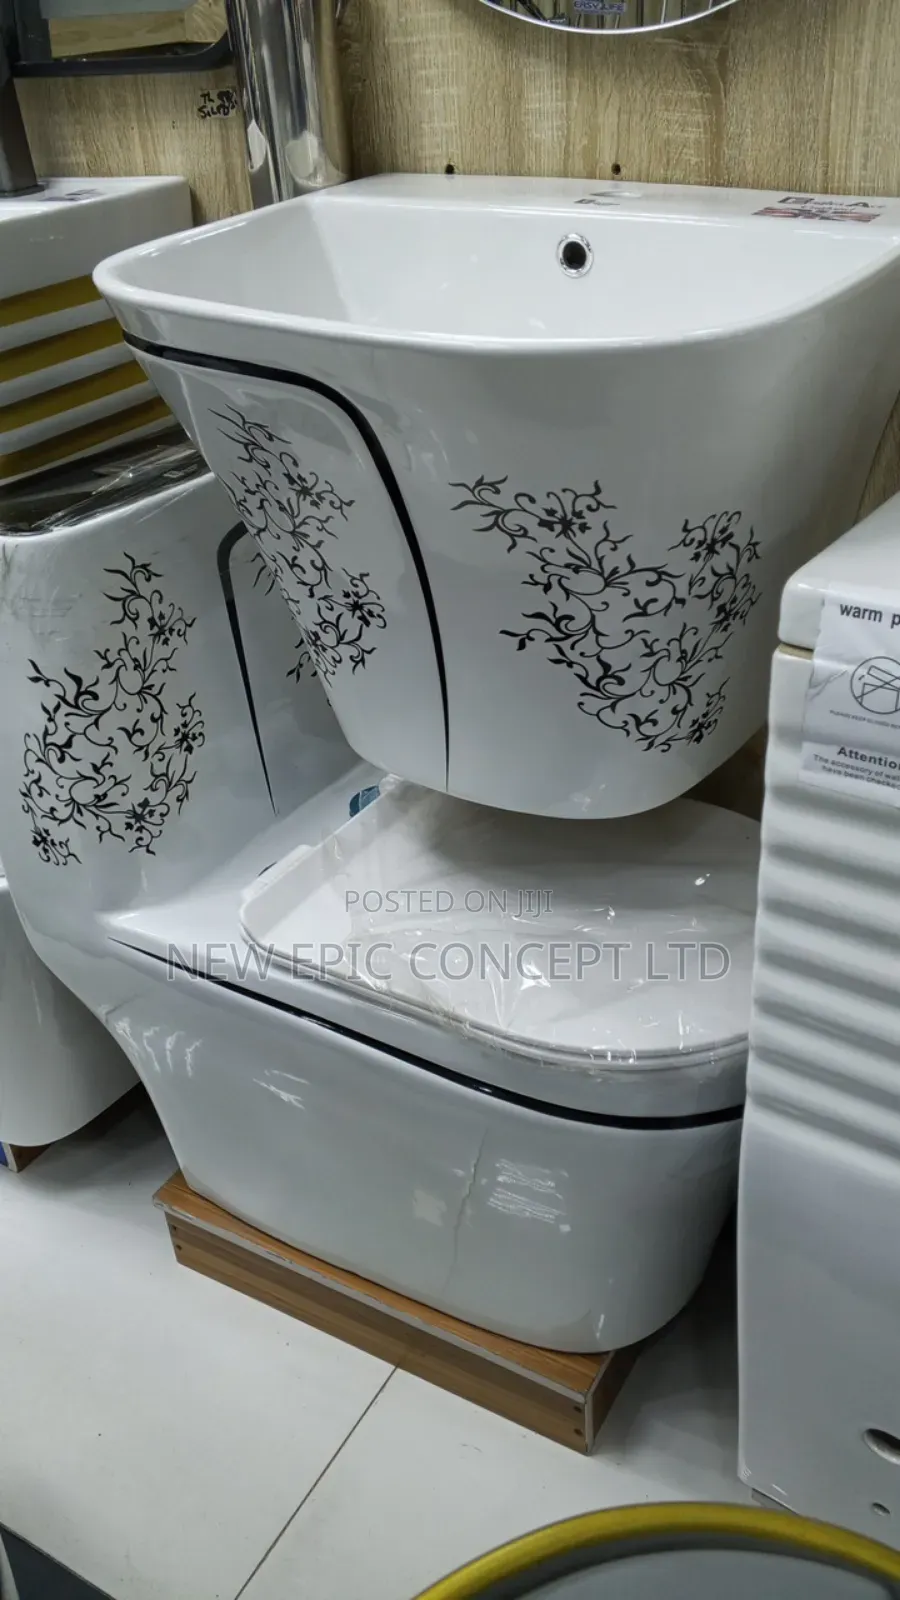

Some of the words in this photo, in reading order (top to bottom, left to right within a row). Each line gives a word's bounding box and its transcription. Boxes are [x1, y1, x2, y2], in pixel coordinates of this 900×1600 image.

[839, 603, 883, 623] warm
[813, 754, 829, 764] The
[830, 759, 873, 776] accessory
[837, 746, 900, 770] Attentio
[822, 765, 842, 776] have
[844, 770, 865, 781] been
